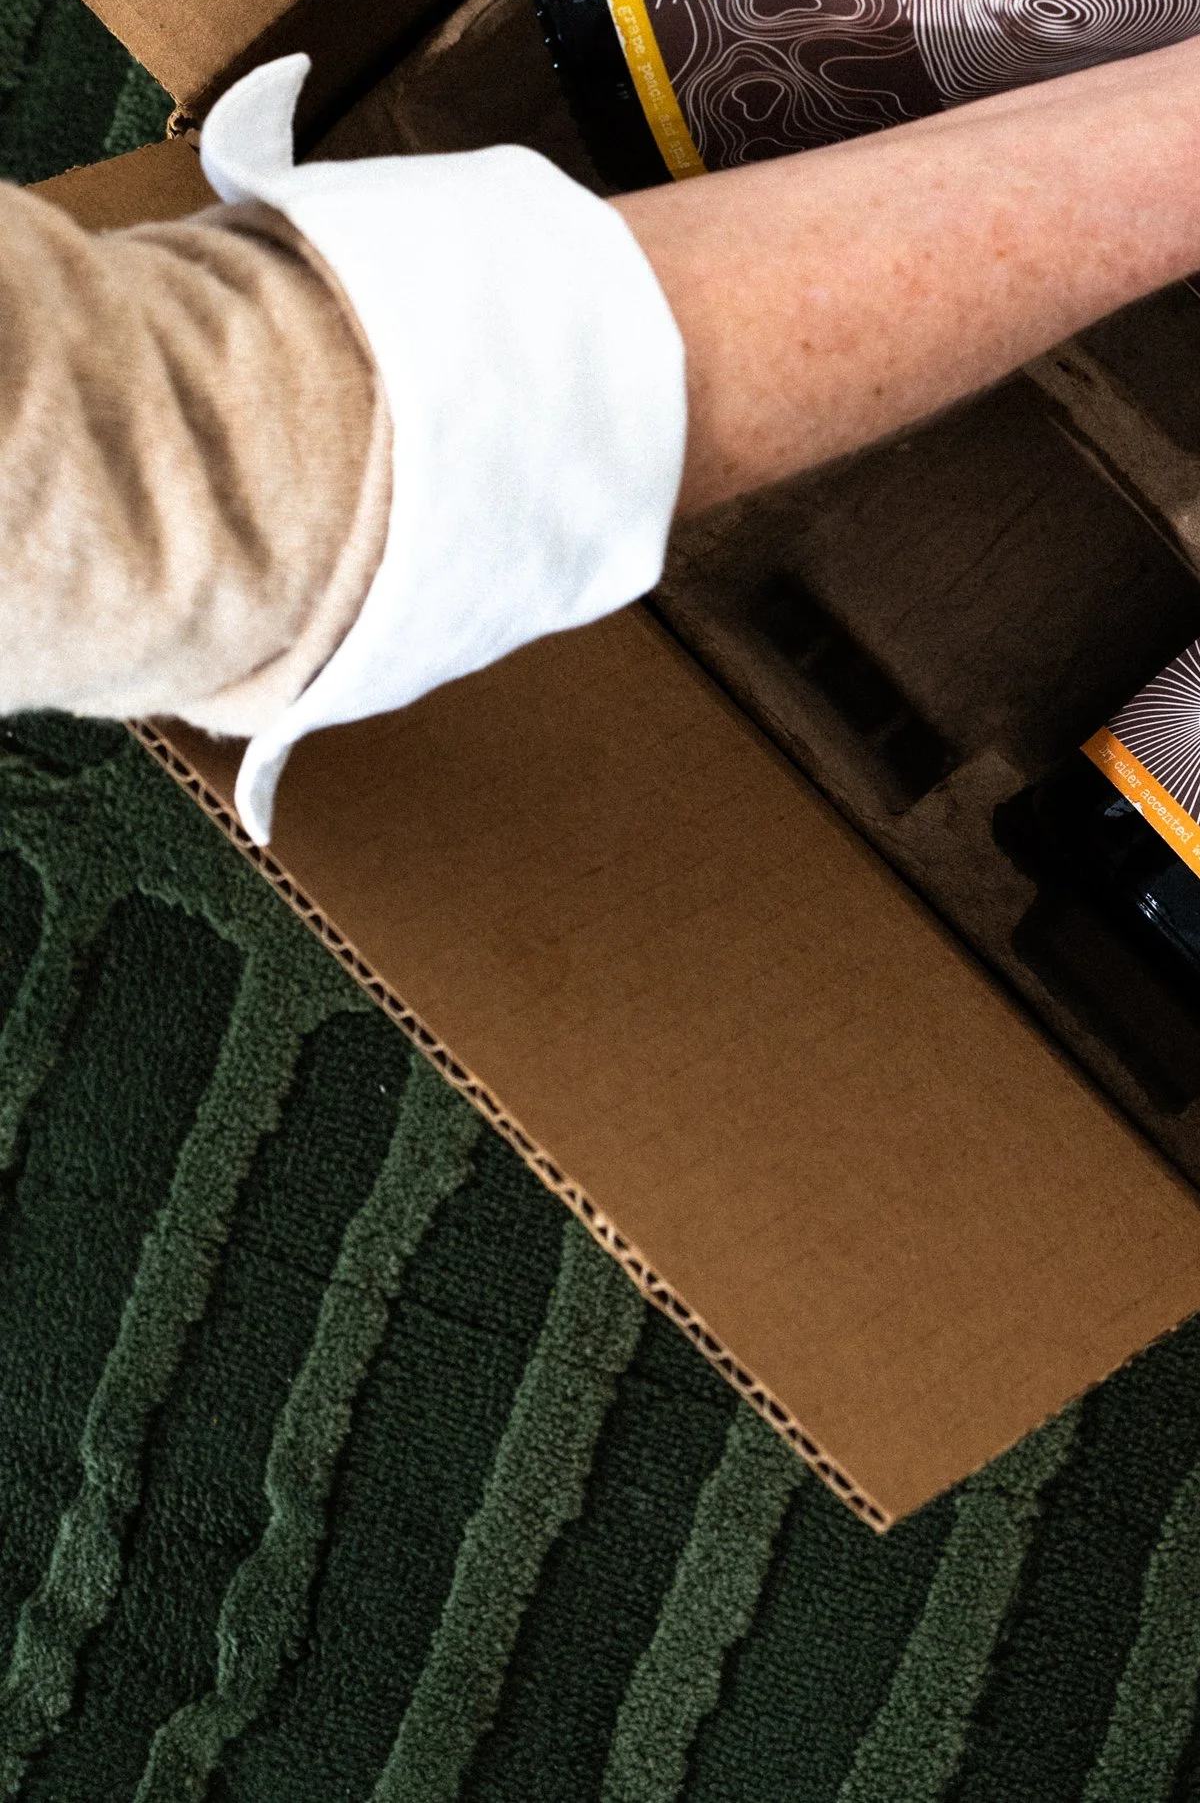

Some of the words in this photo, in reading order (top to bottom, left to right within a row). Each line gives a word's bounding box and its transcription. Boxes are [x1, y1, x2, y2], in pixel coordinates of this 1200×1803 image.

[659, 114, 679, 137] and
[1098, 744, 1116, 764] Dry
[1114, 761, 1141, 788] cider
[1140, 788, 1193, 844] accented
